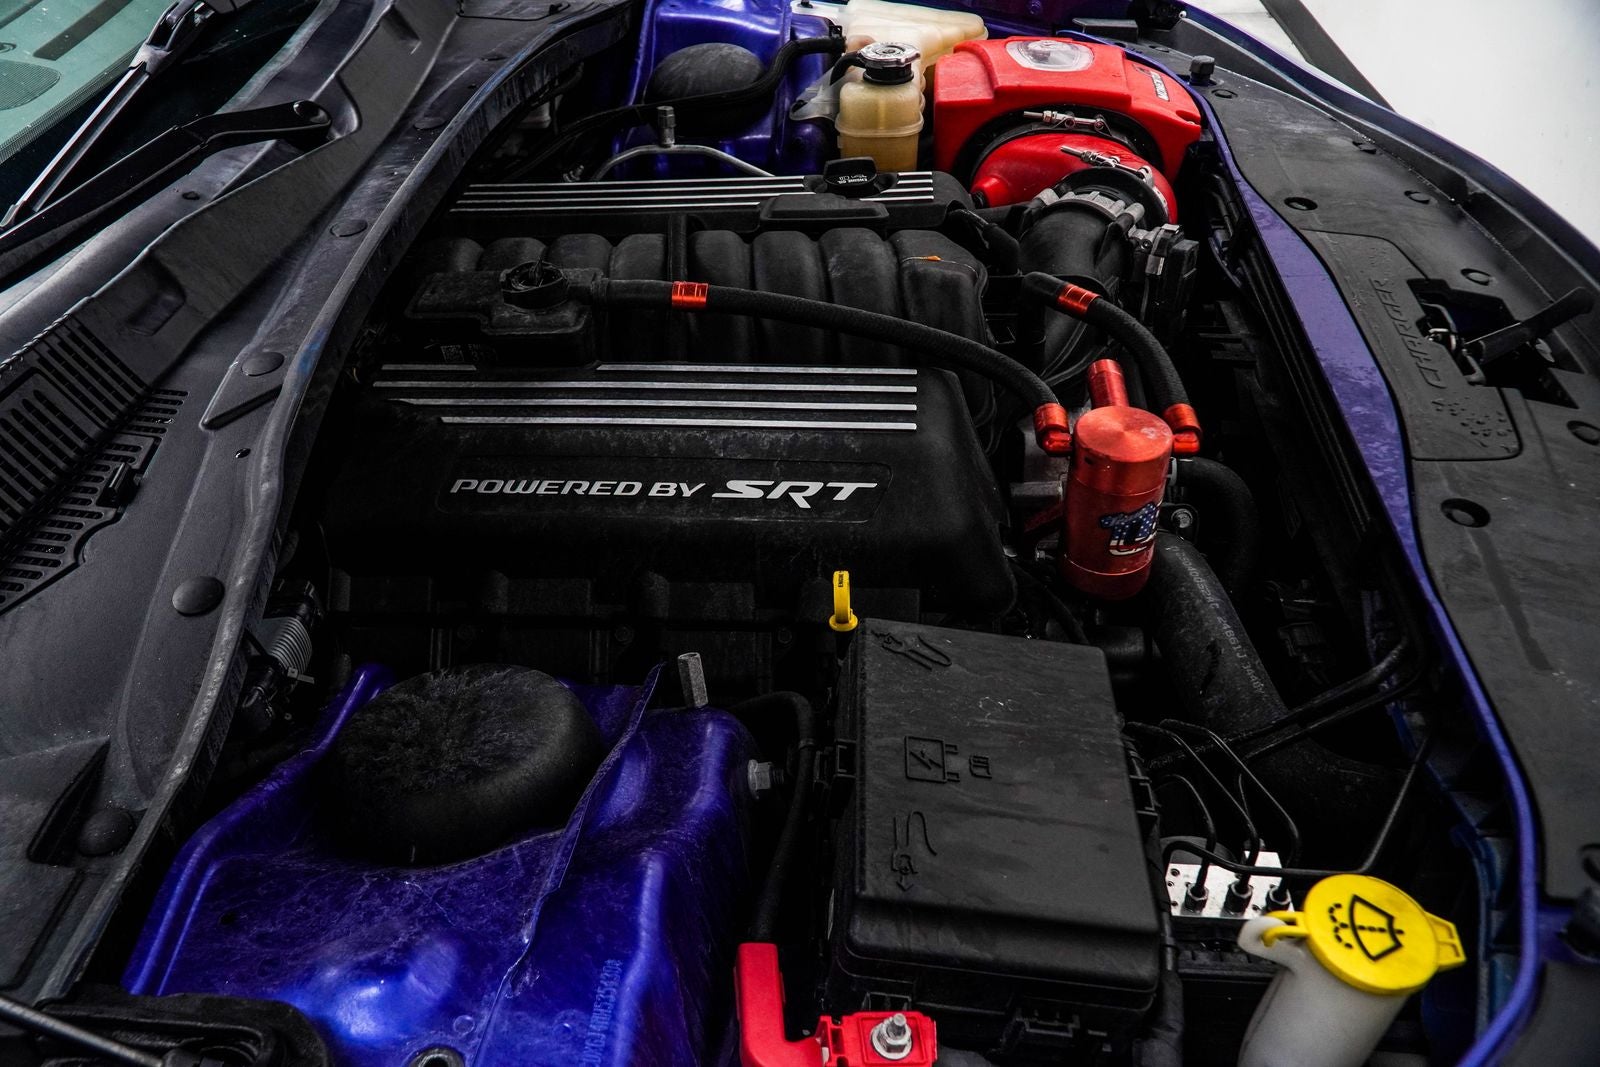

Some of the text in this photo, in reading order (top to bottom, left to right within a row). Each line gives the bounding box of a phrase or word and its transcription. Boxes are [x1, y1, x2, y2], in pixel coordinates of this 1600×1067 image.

[1369, 278, 1447, 389] CHARGER
[450, 479, 878, 509] POWERED BY SRT
